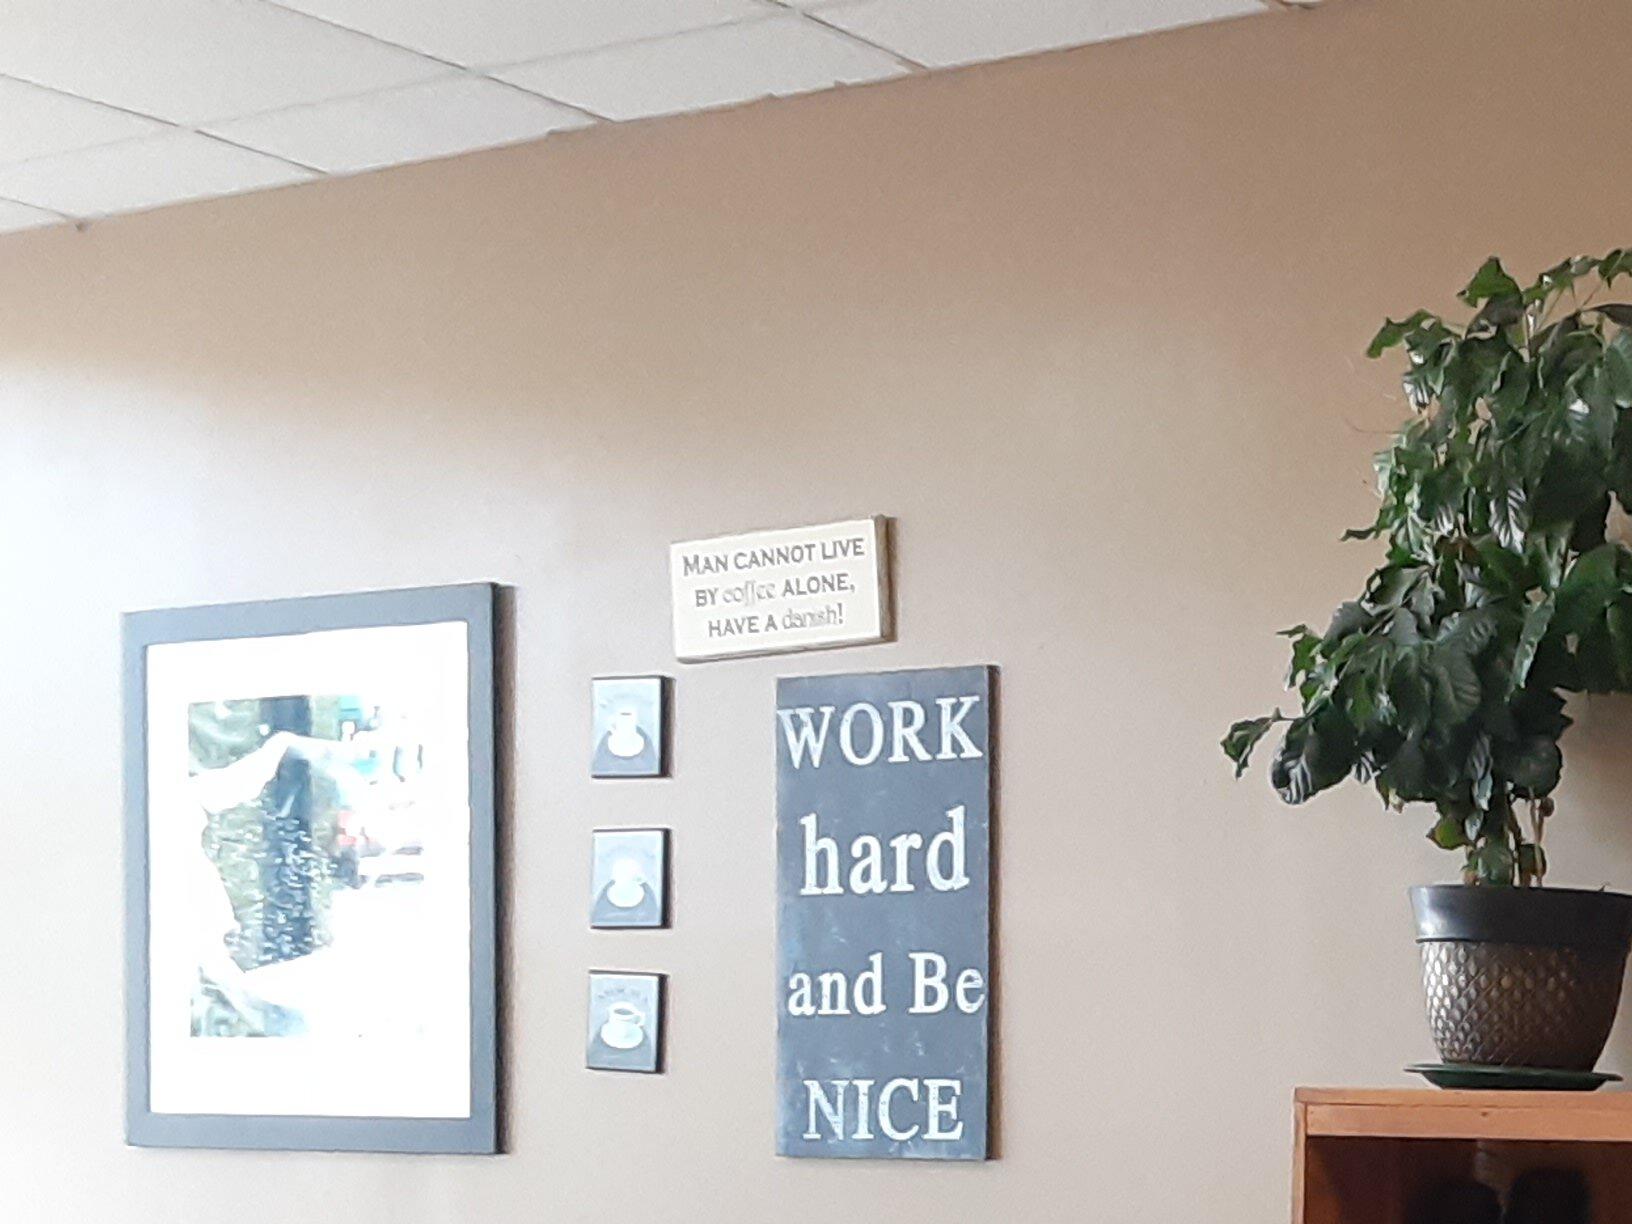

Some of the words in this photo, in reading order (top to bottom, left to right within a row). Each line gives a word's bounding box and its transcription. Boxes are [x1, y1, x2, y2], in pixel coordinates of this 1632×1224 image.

[734, 544, 816, 569] CANNOT
[821, 538, 865, 560] LIVE
[695, 589, 717, 607] BY
[722, 580, 776, 607] coffee
[782, 573, 856, 597] ALONE,
[708, 616, 759, 638] HAVE
[764, 615, 778, 632] A
[782, 603, 843, 629] danish!
[777, 695, 983, 769] WORK
[800, 805, 970, 896] hard
[788, 951, 887, 1016] and
[908, 951, 986, 1014] Be
[803, 1078, 963, 1141] NICE
